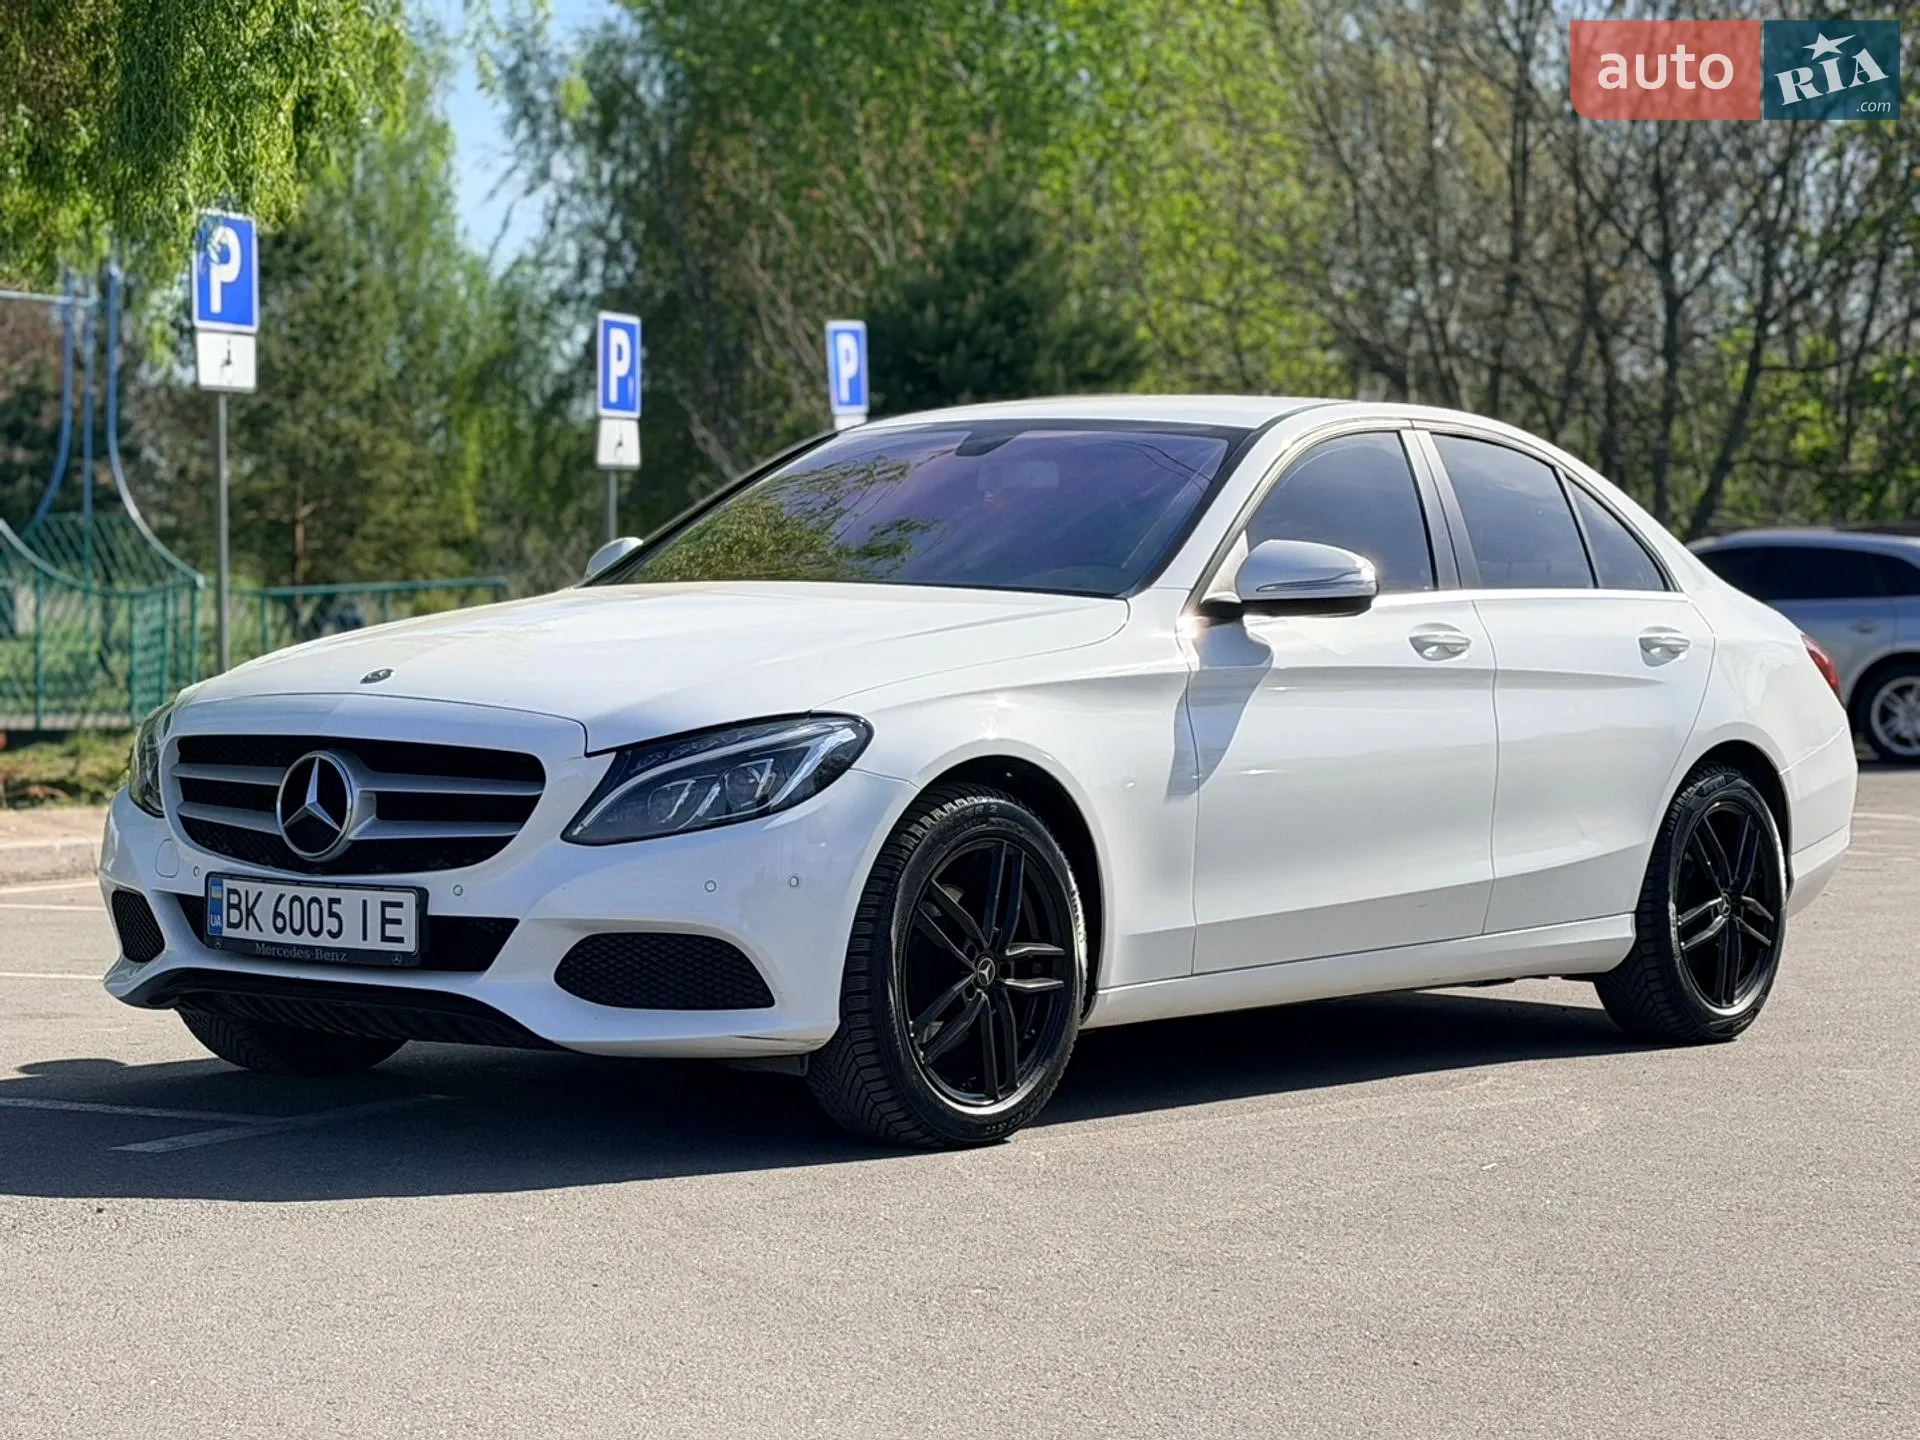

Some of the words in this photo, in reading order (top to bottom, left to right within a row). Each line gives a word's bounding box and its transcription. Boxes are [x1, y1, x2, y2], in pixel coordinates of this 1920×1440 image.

[207, 226, 241, 314] P
[609, 327, 631, 404] P
[836, 332, 858, 403] P
[226, 888, 264, 933] BK
[272, 893, 343, 939] 6005
[361, 899, 405, 944] IE
[254, 942, 348, 962] Mercedes-Benz
